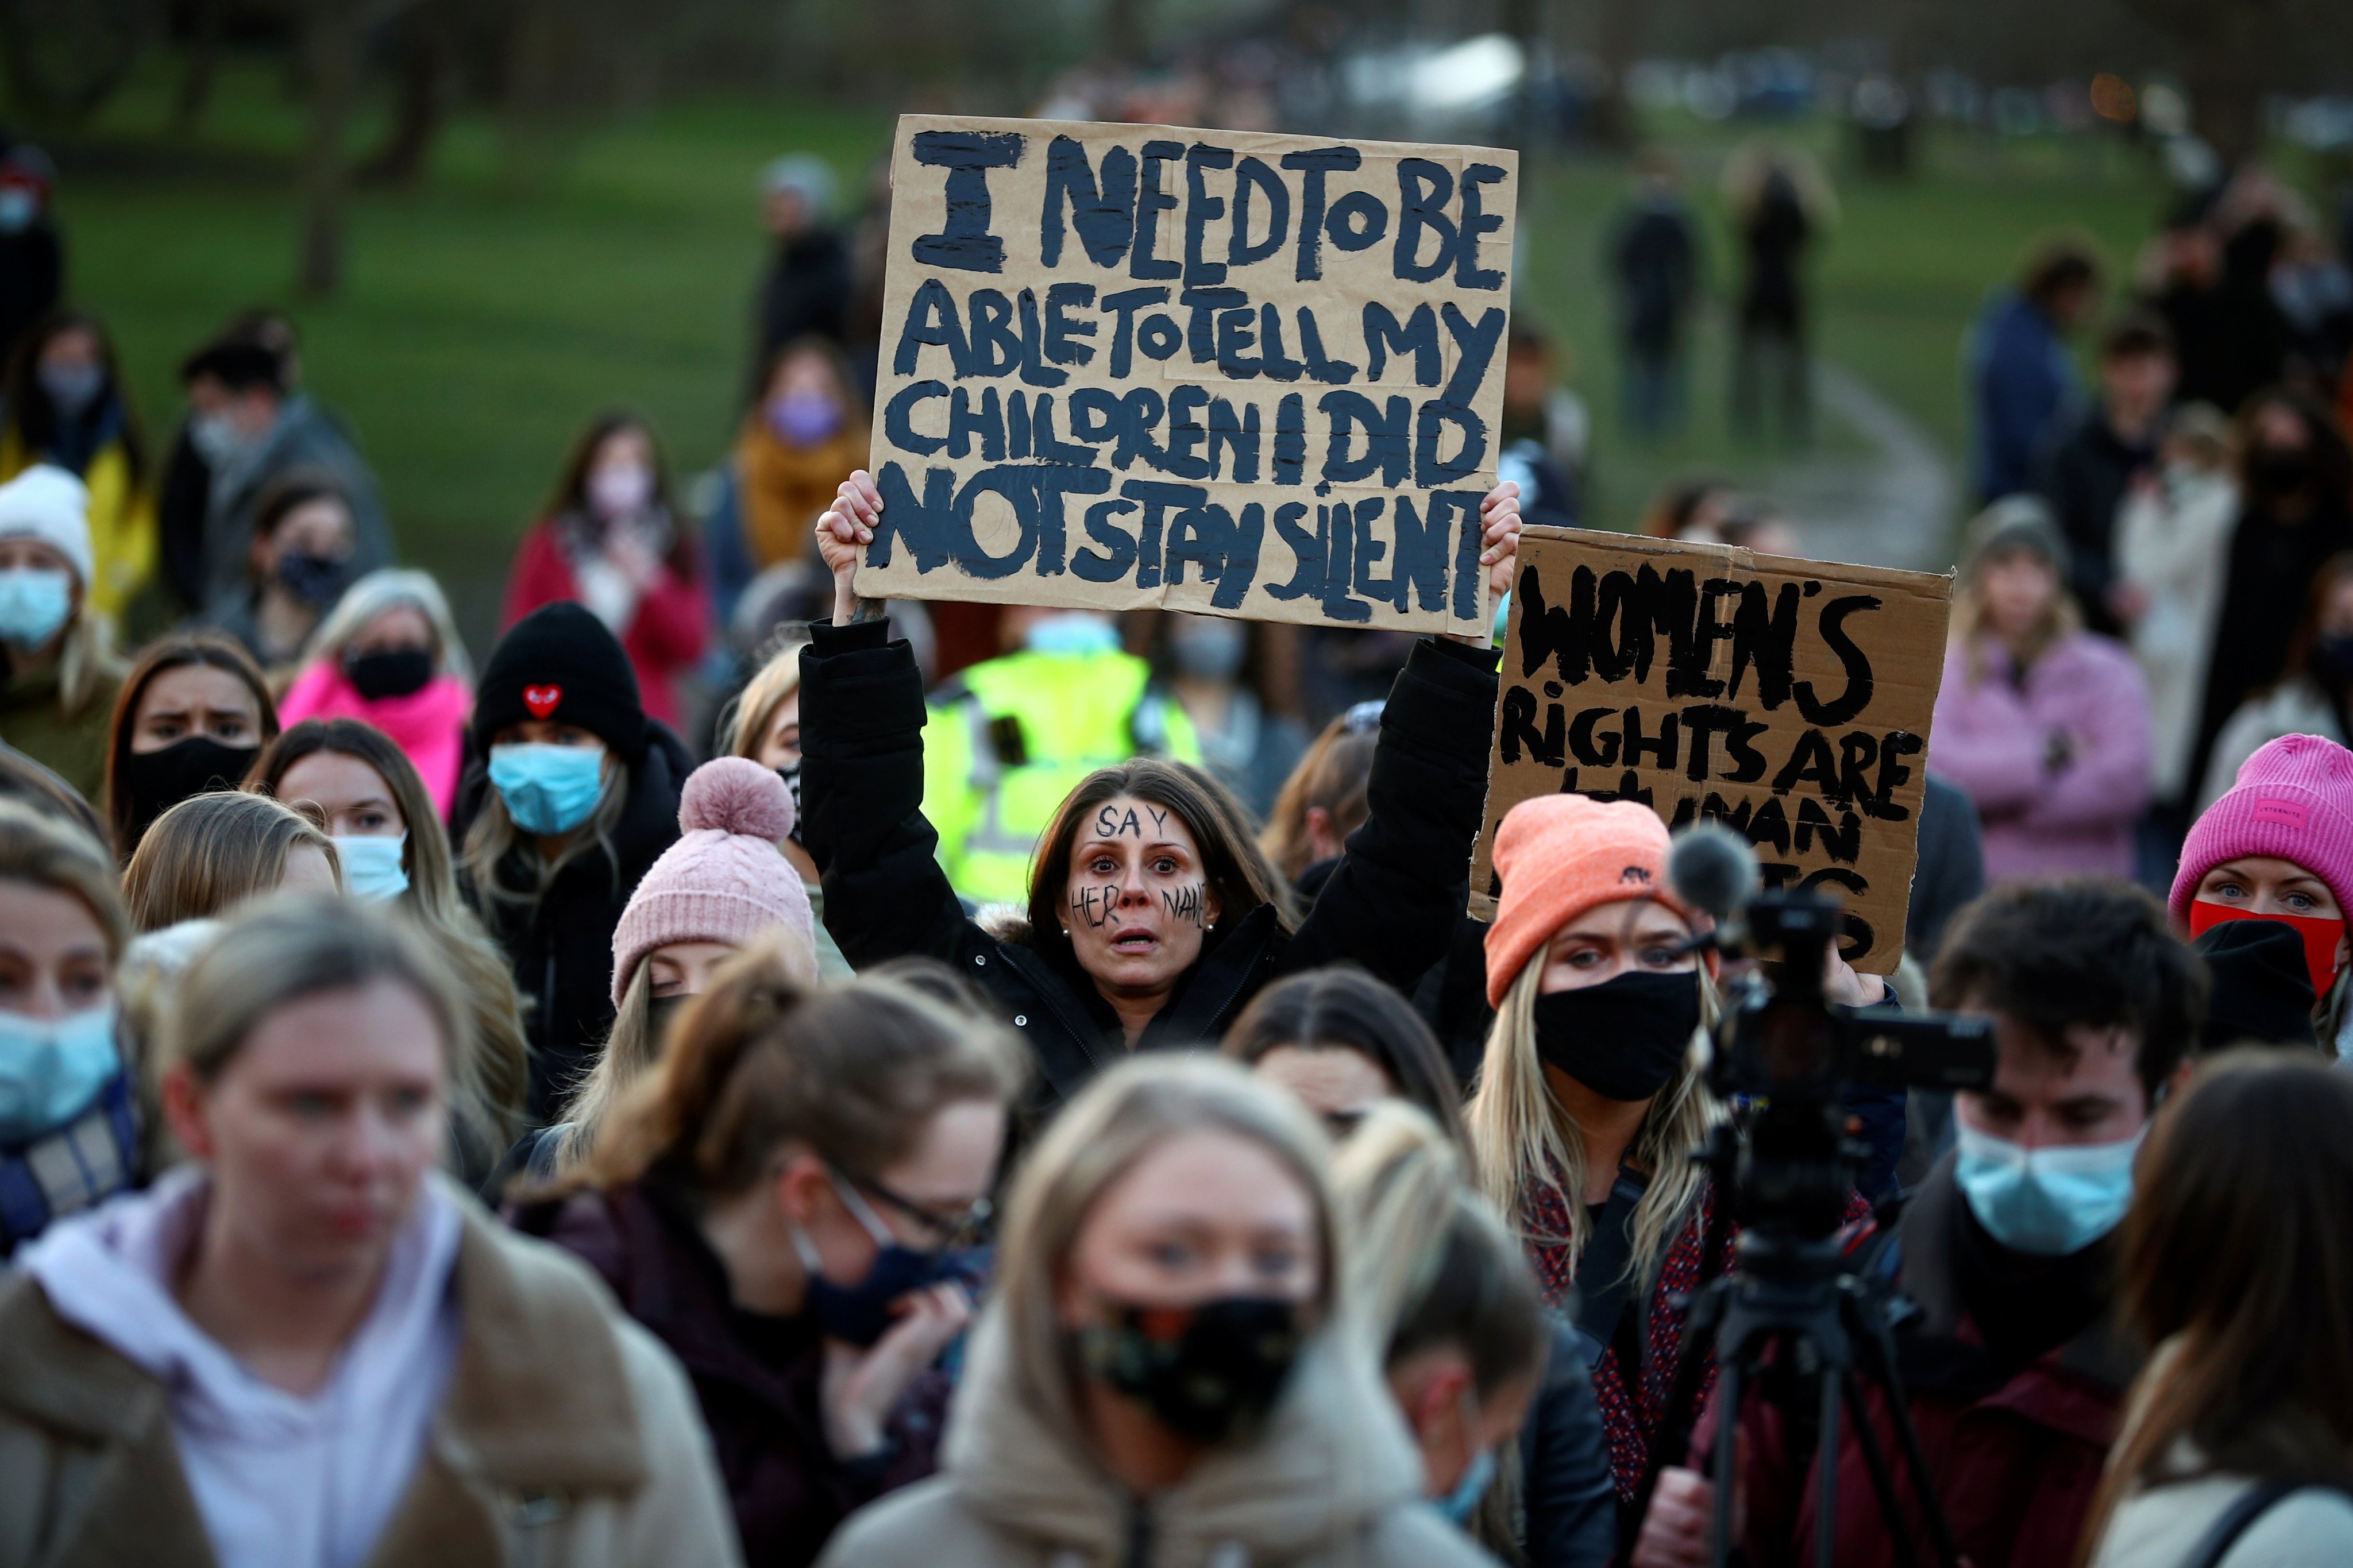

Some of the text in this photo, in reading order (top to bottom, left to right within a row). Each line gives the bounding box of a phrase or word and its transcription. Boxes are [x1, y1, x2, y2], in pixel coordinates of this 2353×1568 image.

[910, 130, 1508, 291] I NEED TO BE
[893, 278, 1505, 405] ABLE TO TELL MY
[884, 379, 1491, 487] CHILDREN I DID
[865, 461, 1490, 622] NOT STAY SILENT
[1519, 562, 1883, 727] WOMEN'S
[1499, 681, 1928, 822] RIGHTS ARE
[1096, 805, 1167, 839] SAY
[1071, 882, 1205, 929] HER NAME
